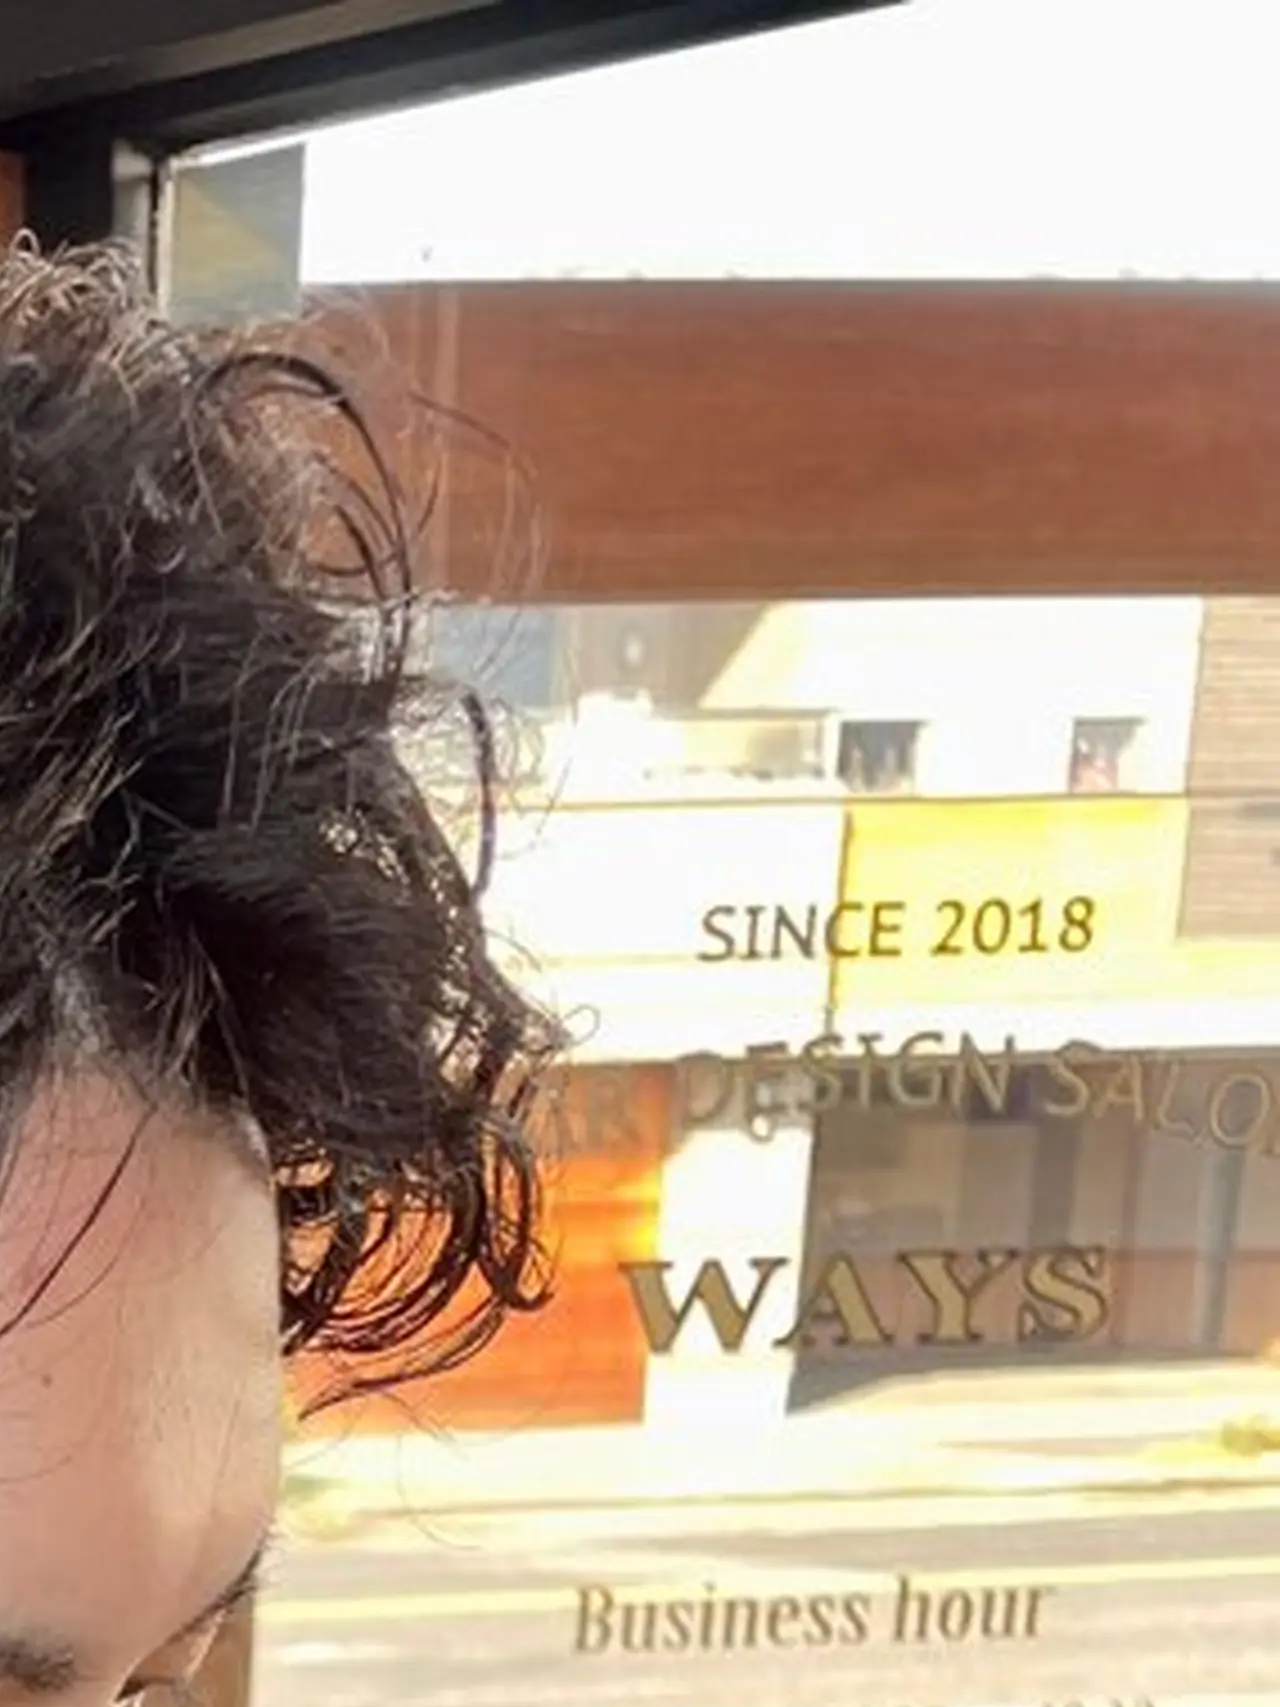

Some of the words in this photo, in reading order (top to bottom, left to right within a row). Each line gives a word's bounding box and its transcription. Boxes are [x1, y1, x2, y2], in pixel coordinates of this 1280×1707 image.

[696, 902, 905, 963] SINCE
[930, 896, 1097, 959] 2018
[676, 1030, 1018, 1124] DESIGN
[1043, 1039, 1280, 1156] SALO
[619, 1244, 1114, 1355] WAYS
[572, 1580, 871, 1656] Business
[891, 1575, 1056, 1643] hour
